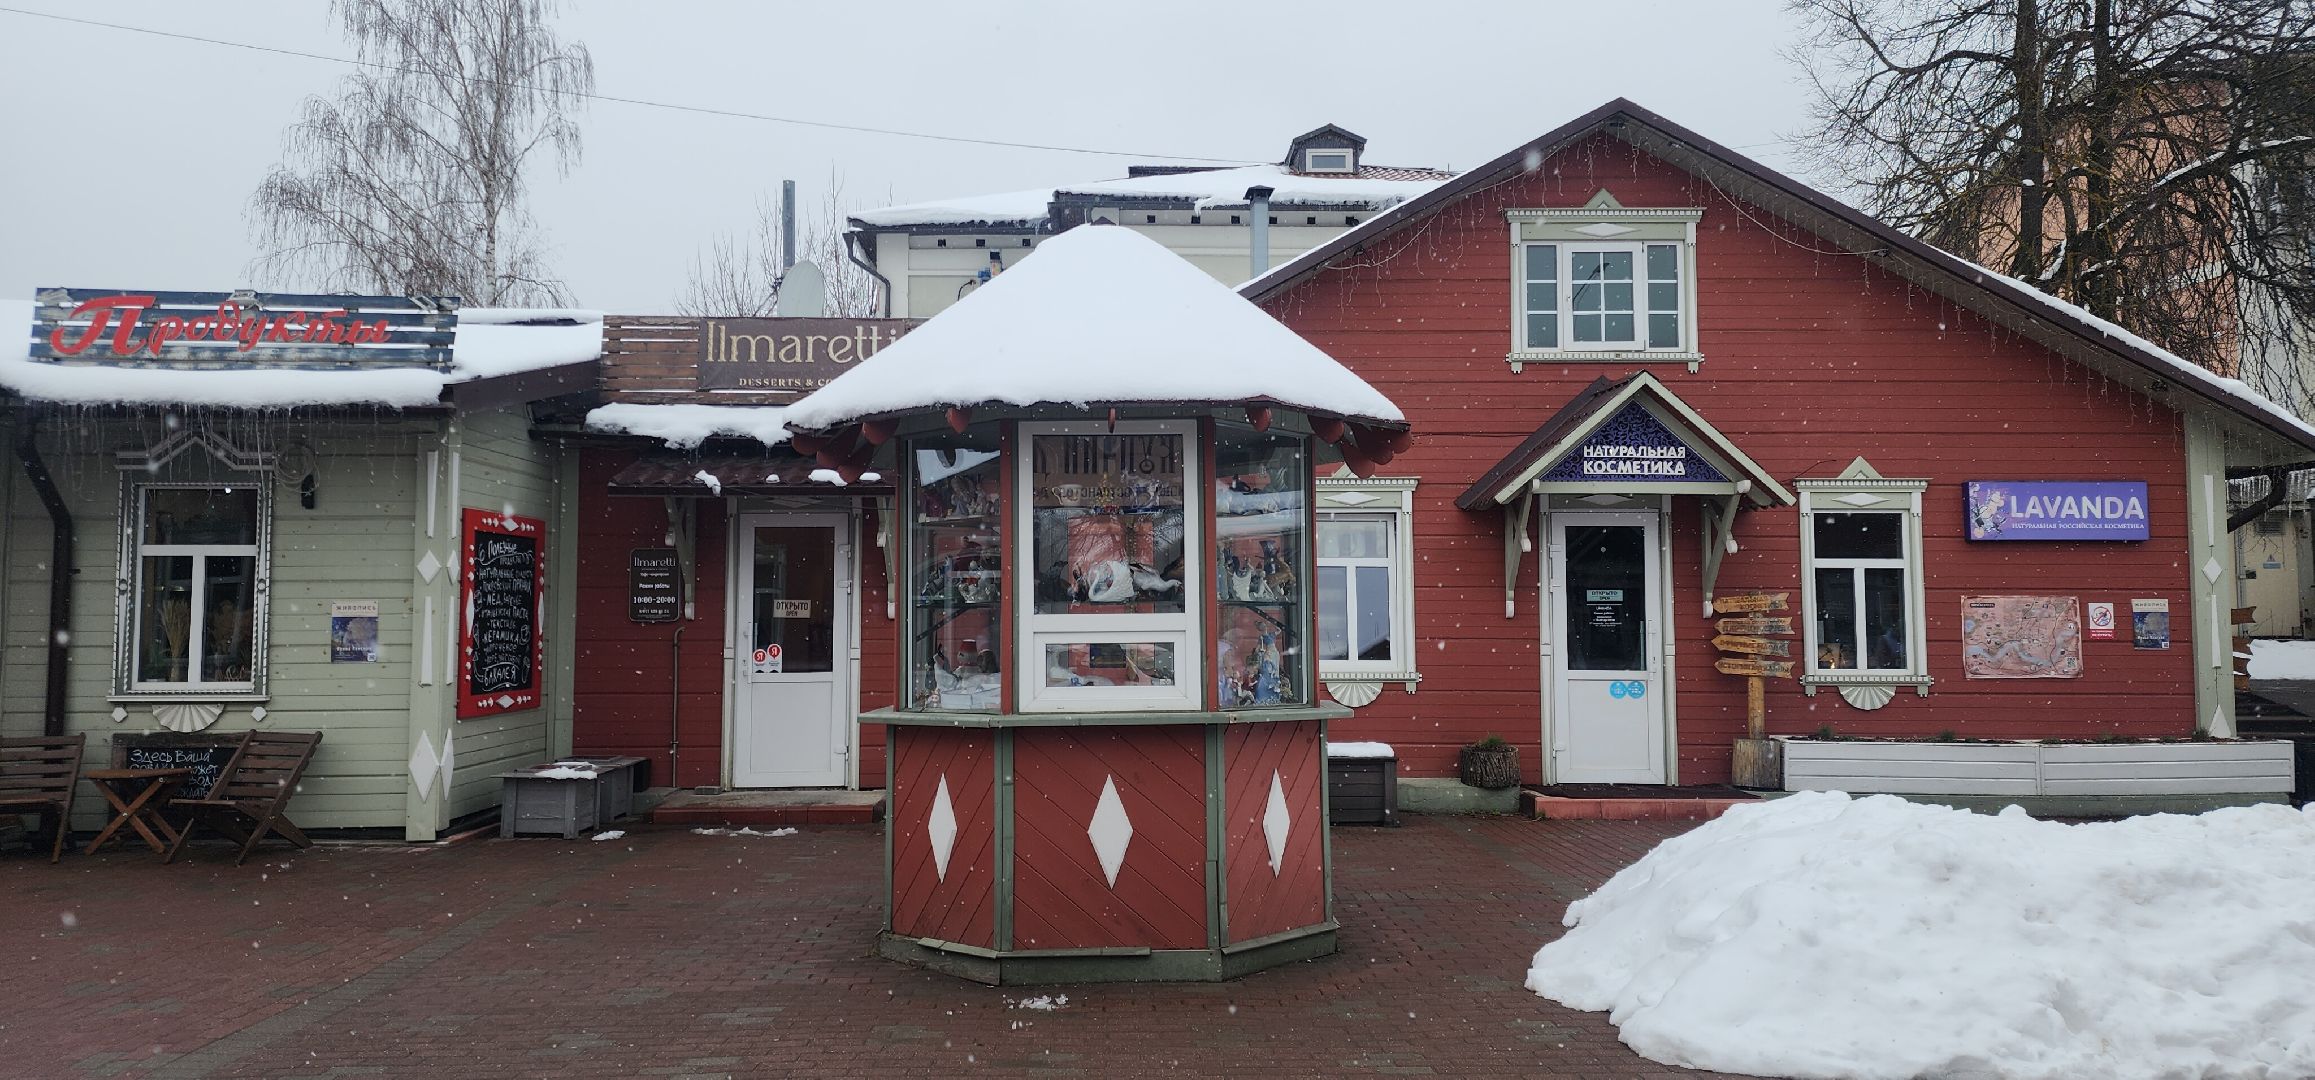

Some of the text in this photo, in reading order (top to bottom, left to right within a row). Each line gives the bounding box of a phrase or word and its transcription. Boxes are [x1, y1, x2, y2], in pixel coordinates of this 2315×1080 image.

[49, 294, 392, 355] Продукты
[738, 377, 833, 387] DESSERTS & CO
[1583, 445, 1686, 459] НАТУРАЛЬНАЯ
[1583, 460, 1686, 475] КОСМЕТИКА
[2010, 495, 2145, 519] LAVANDA
[634, 556, 676, 567] Ilmaretti
[775, 601, 809, 611] ОТКРЫТО
[130, 749, 210, 763] Здесь Ваша
